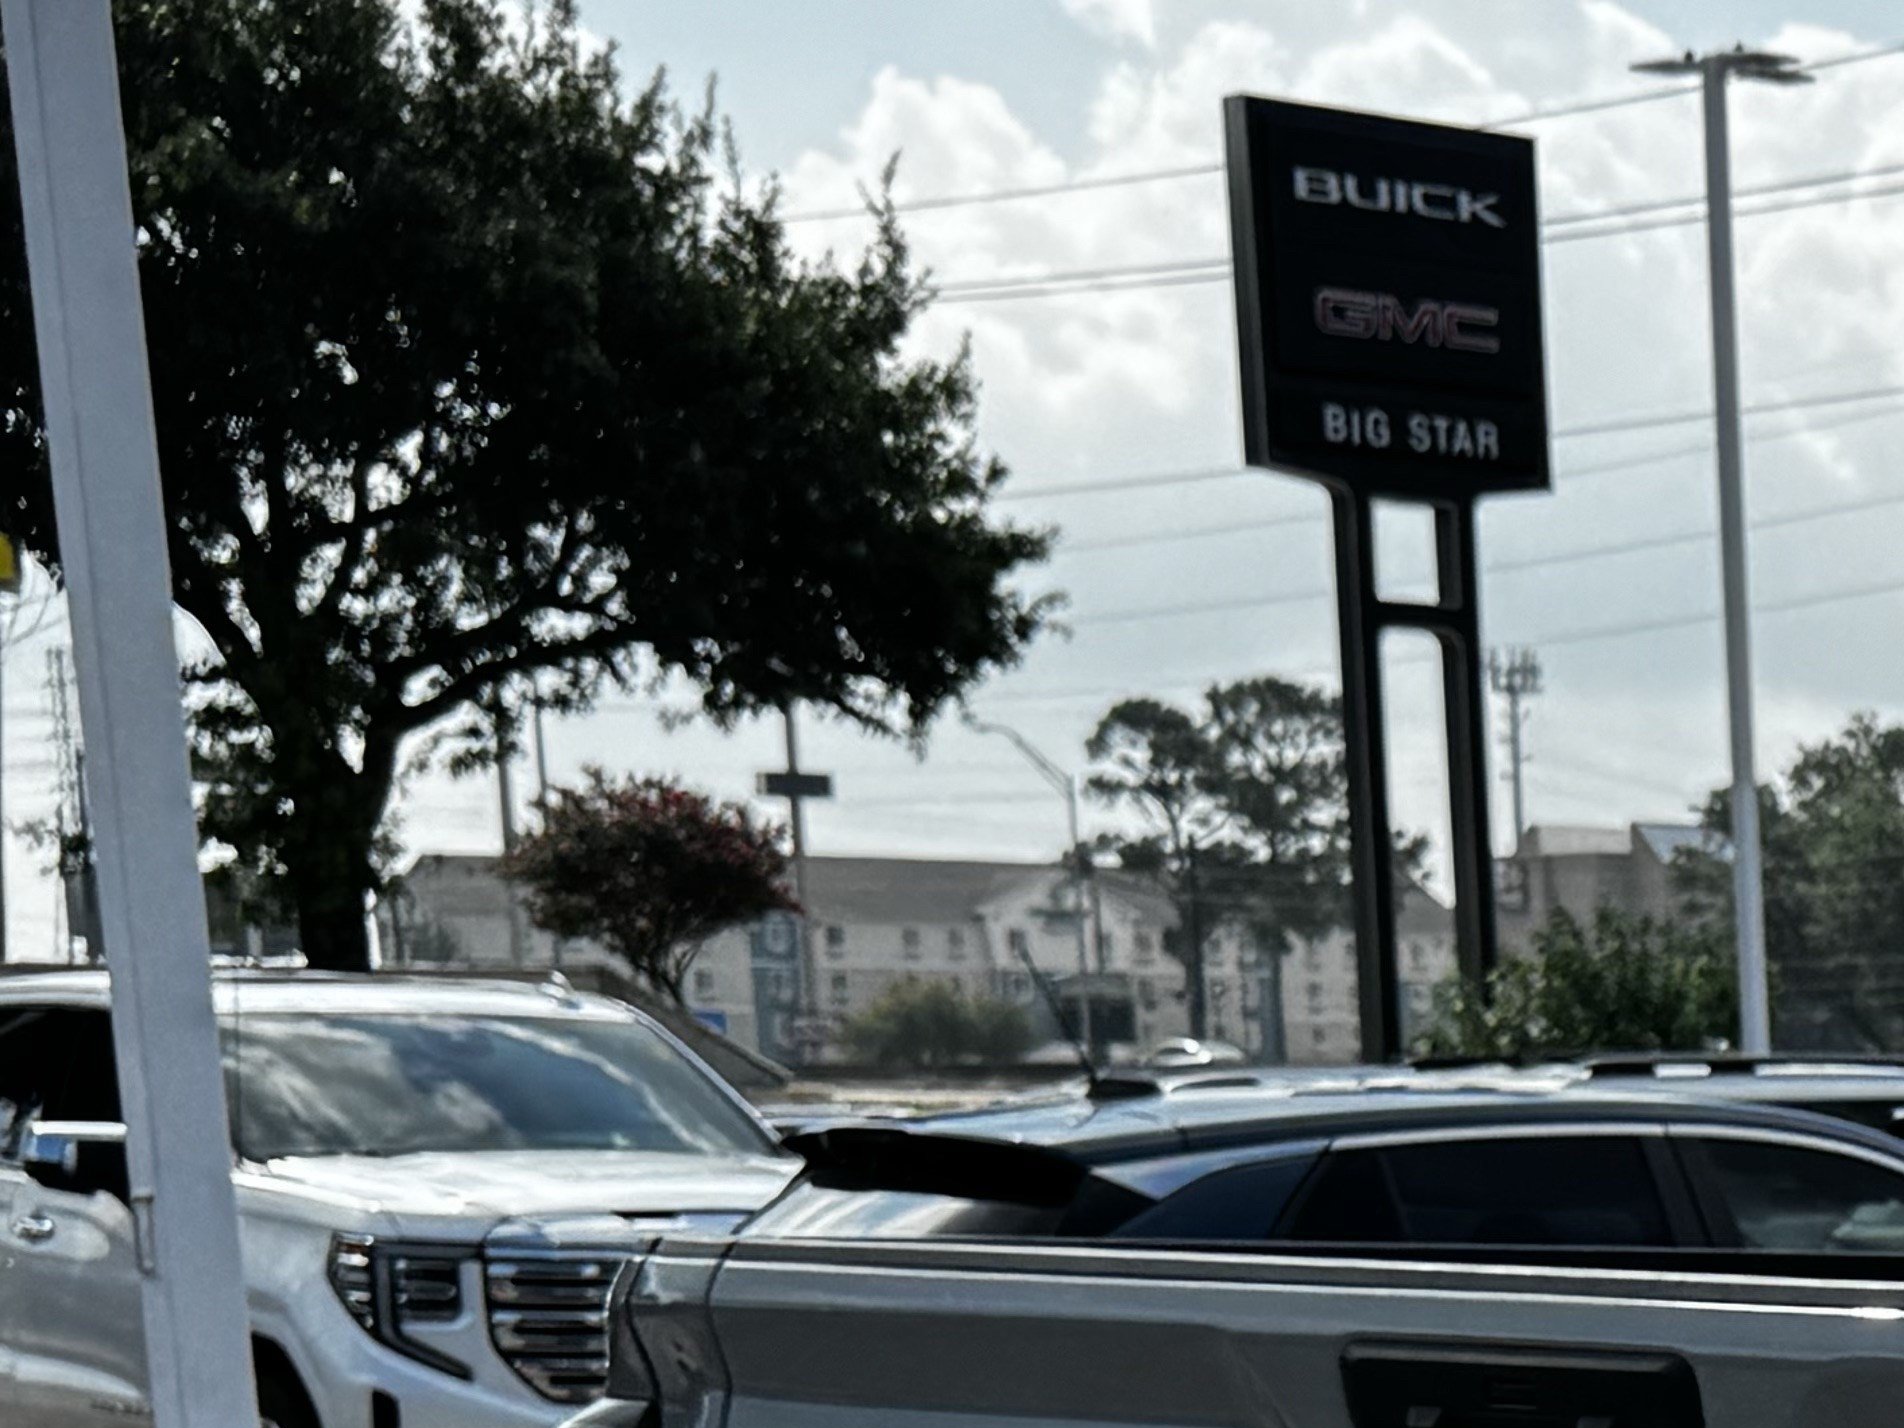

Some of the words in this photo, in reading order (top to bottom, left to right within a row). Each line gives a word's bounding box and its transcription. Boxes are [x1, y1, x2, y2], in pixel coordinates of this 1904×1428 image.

[1293, 166, 1506, 228] BUICK
[1314, 286, 1500, 354] GMC
[1323, 402, 1390, 448] BIG
[1409, 412, 1499, 460] STAR
